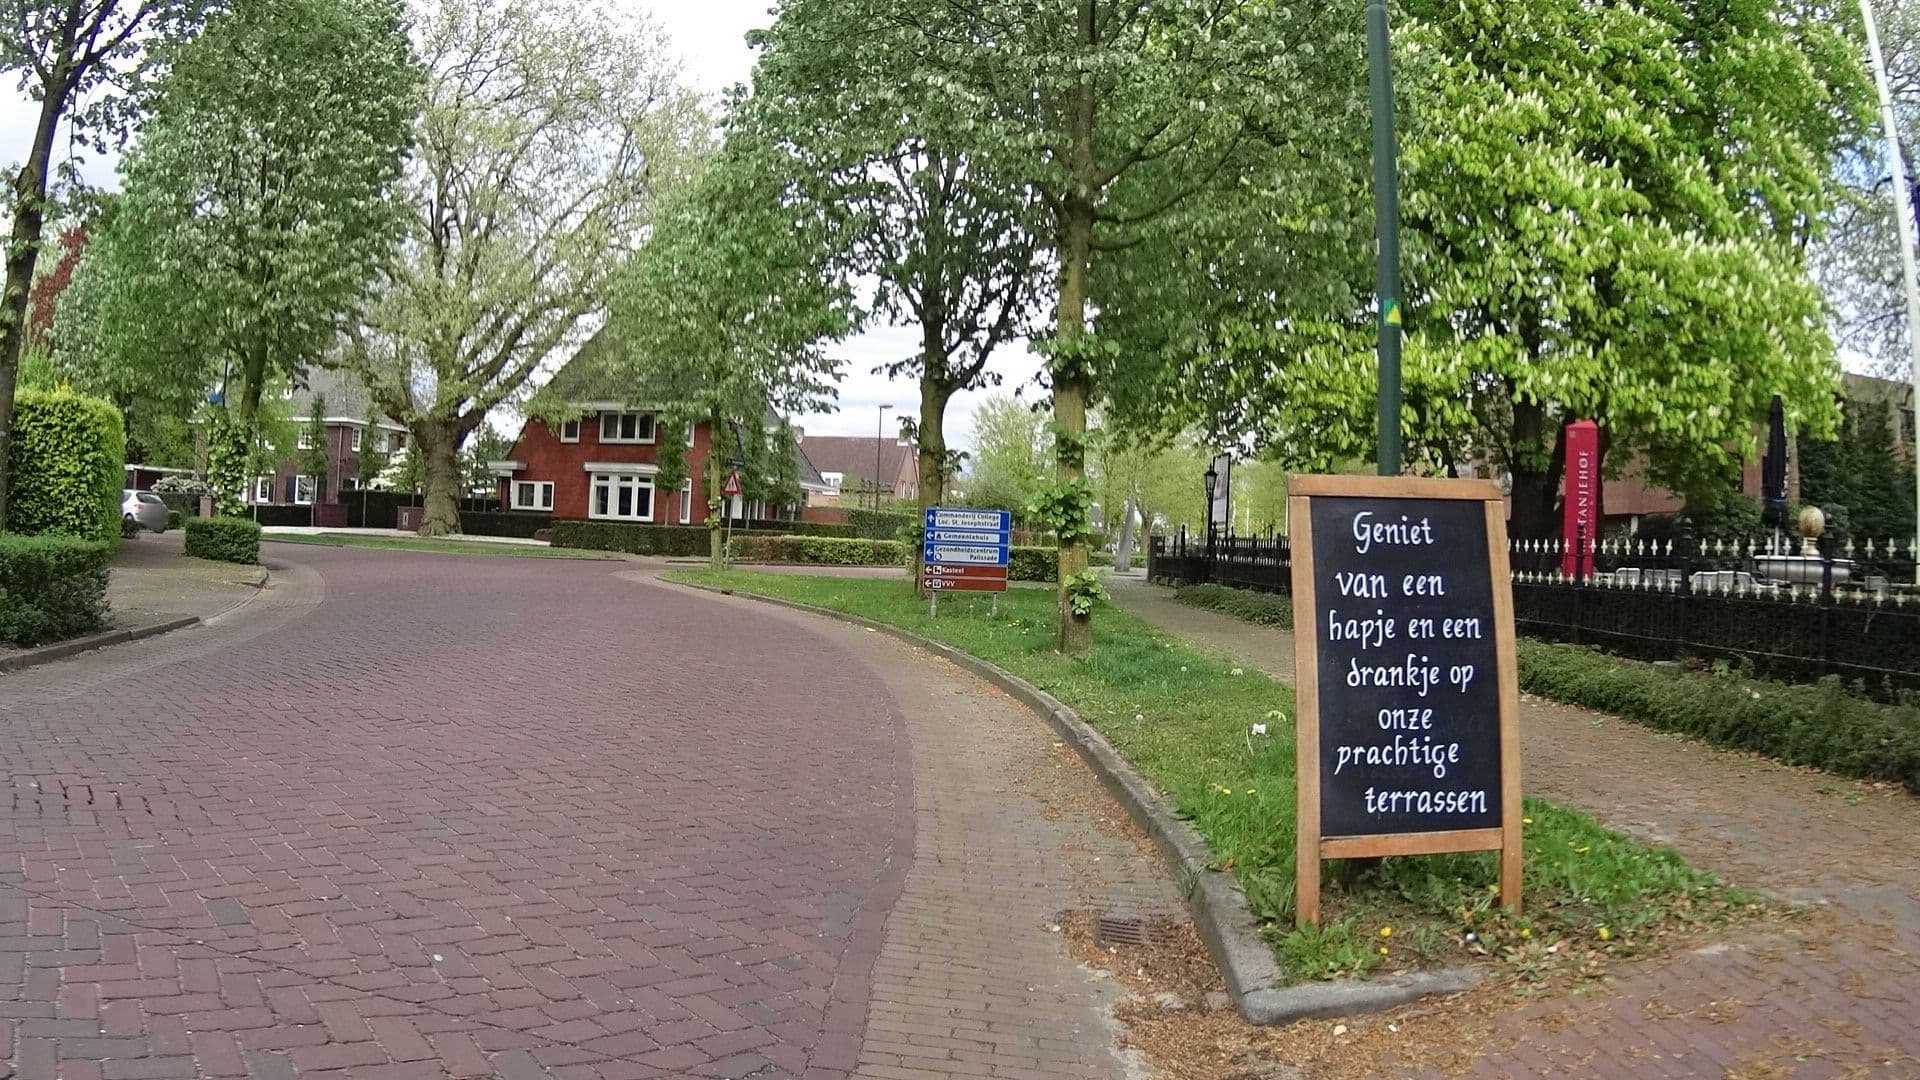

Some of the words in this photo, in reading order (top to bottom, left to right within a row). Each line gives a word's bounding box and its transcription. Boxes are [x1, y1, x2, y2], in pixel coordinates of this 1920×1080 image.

[936, 511, 976, 520] Commanderij
[977, 513, 999, 521] College
[961, 519, 999, 528] Josephstraat
[1352, 511, 1434, 554] Geniet
[935, 546, 998, 554] Gezondheidscentrum
[1335, 572, 1388, 598] van
[1403, 574, 1444, 597] een
[1329, 609, 1396, 649] hapje
[1408, 619, 1435, 639] en
[1443, 617, 1482, 639] een
[1347, 654, 1440, 697] drankje
[1450, 665, 1474, 693] op
[1378, 709, 1433, 730] onze
[1335, 735, 1459, 779] prachtige
[1365, 786, 1487, 814] terrassen
